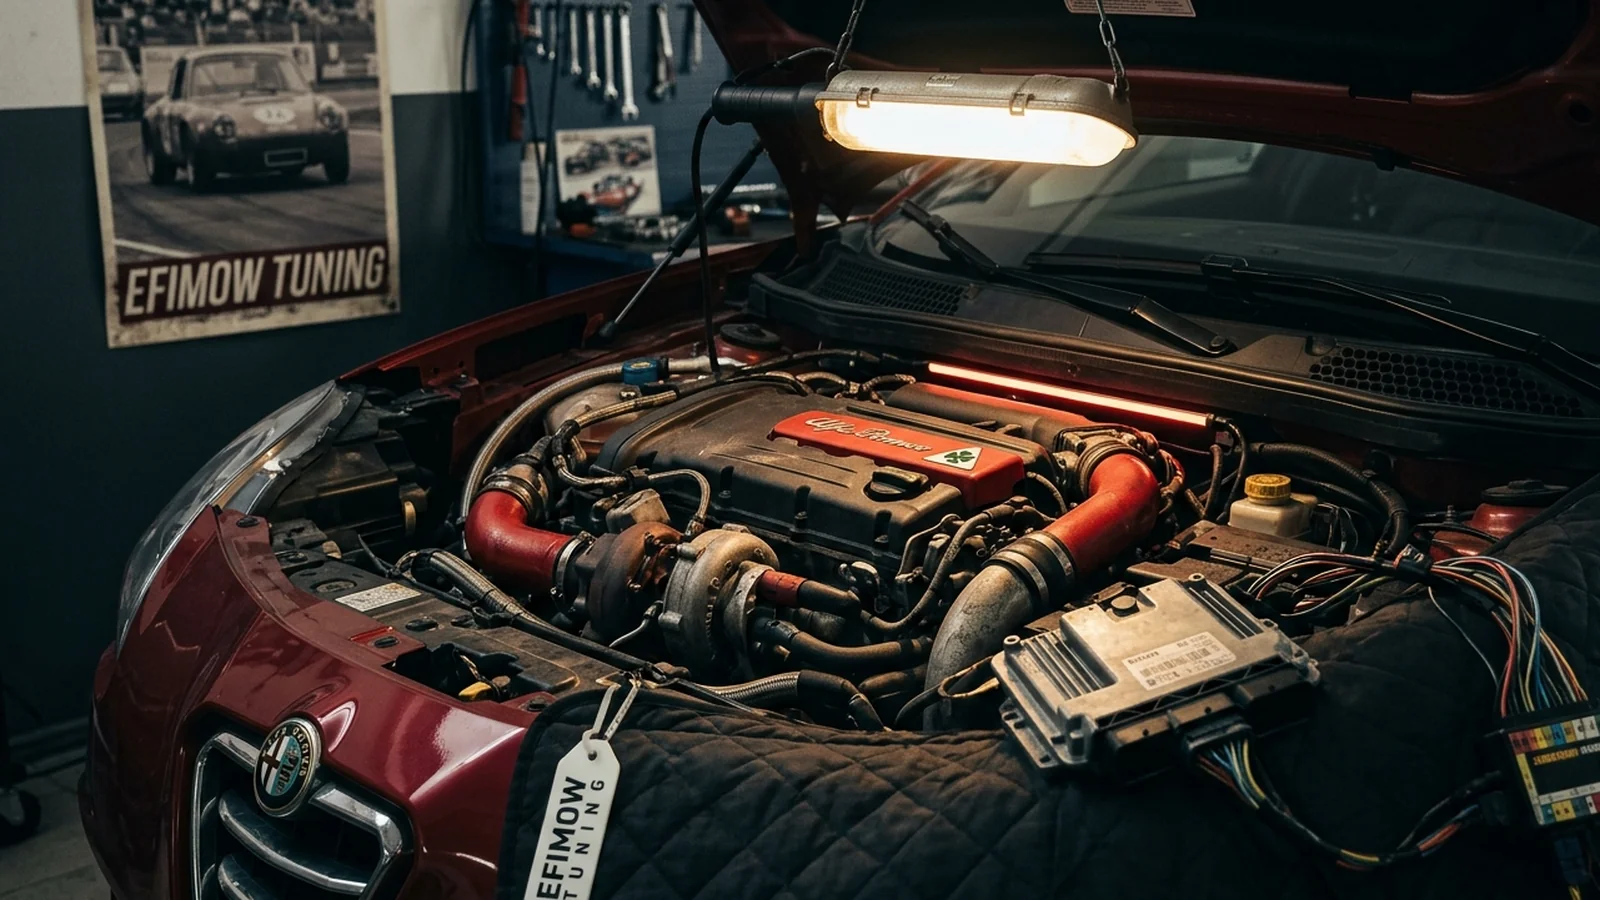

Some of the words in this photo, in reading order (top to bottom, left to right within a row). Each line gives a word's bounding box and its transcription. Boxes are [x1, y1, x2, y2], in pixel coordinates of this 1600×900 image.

[123, 257, 265, 317] EFIMOW
[272, 246, 386, 299] TUNING
[536, 776, 587, 900] EFIMOW
[562, 779, 605, 900] TUNING
